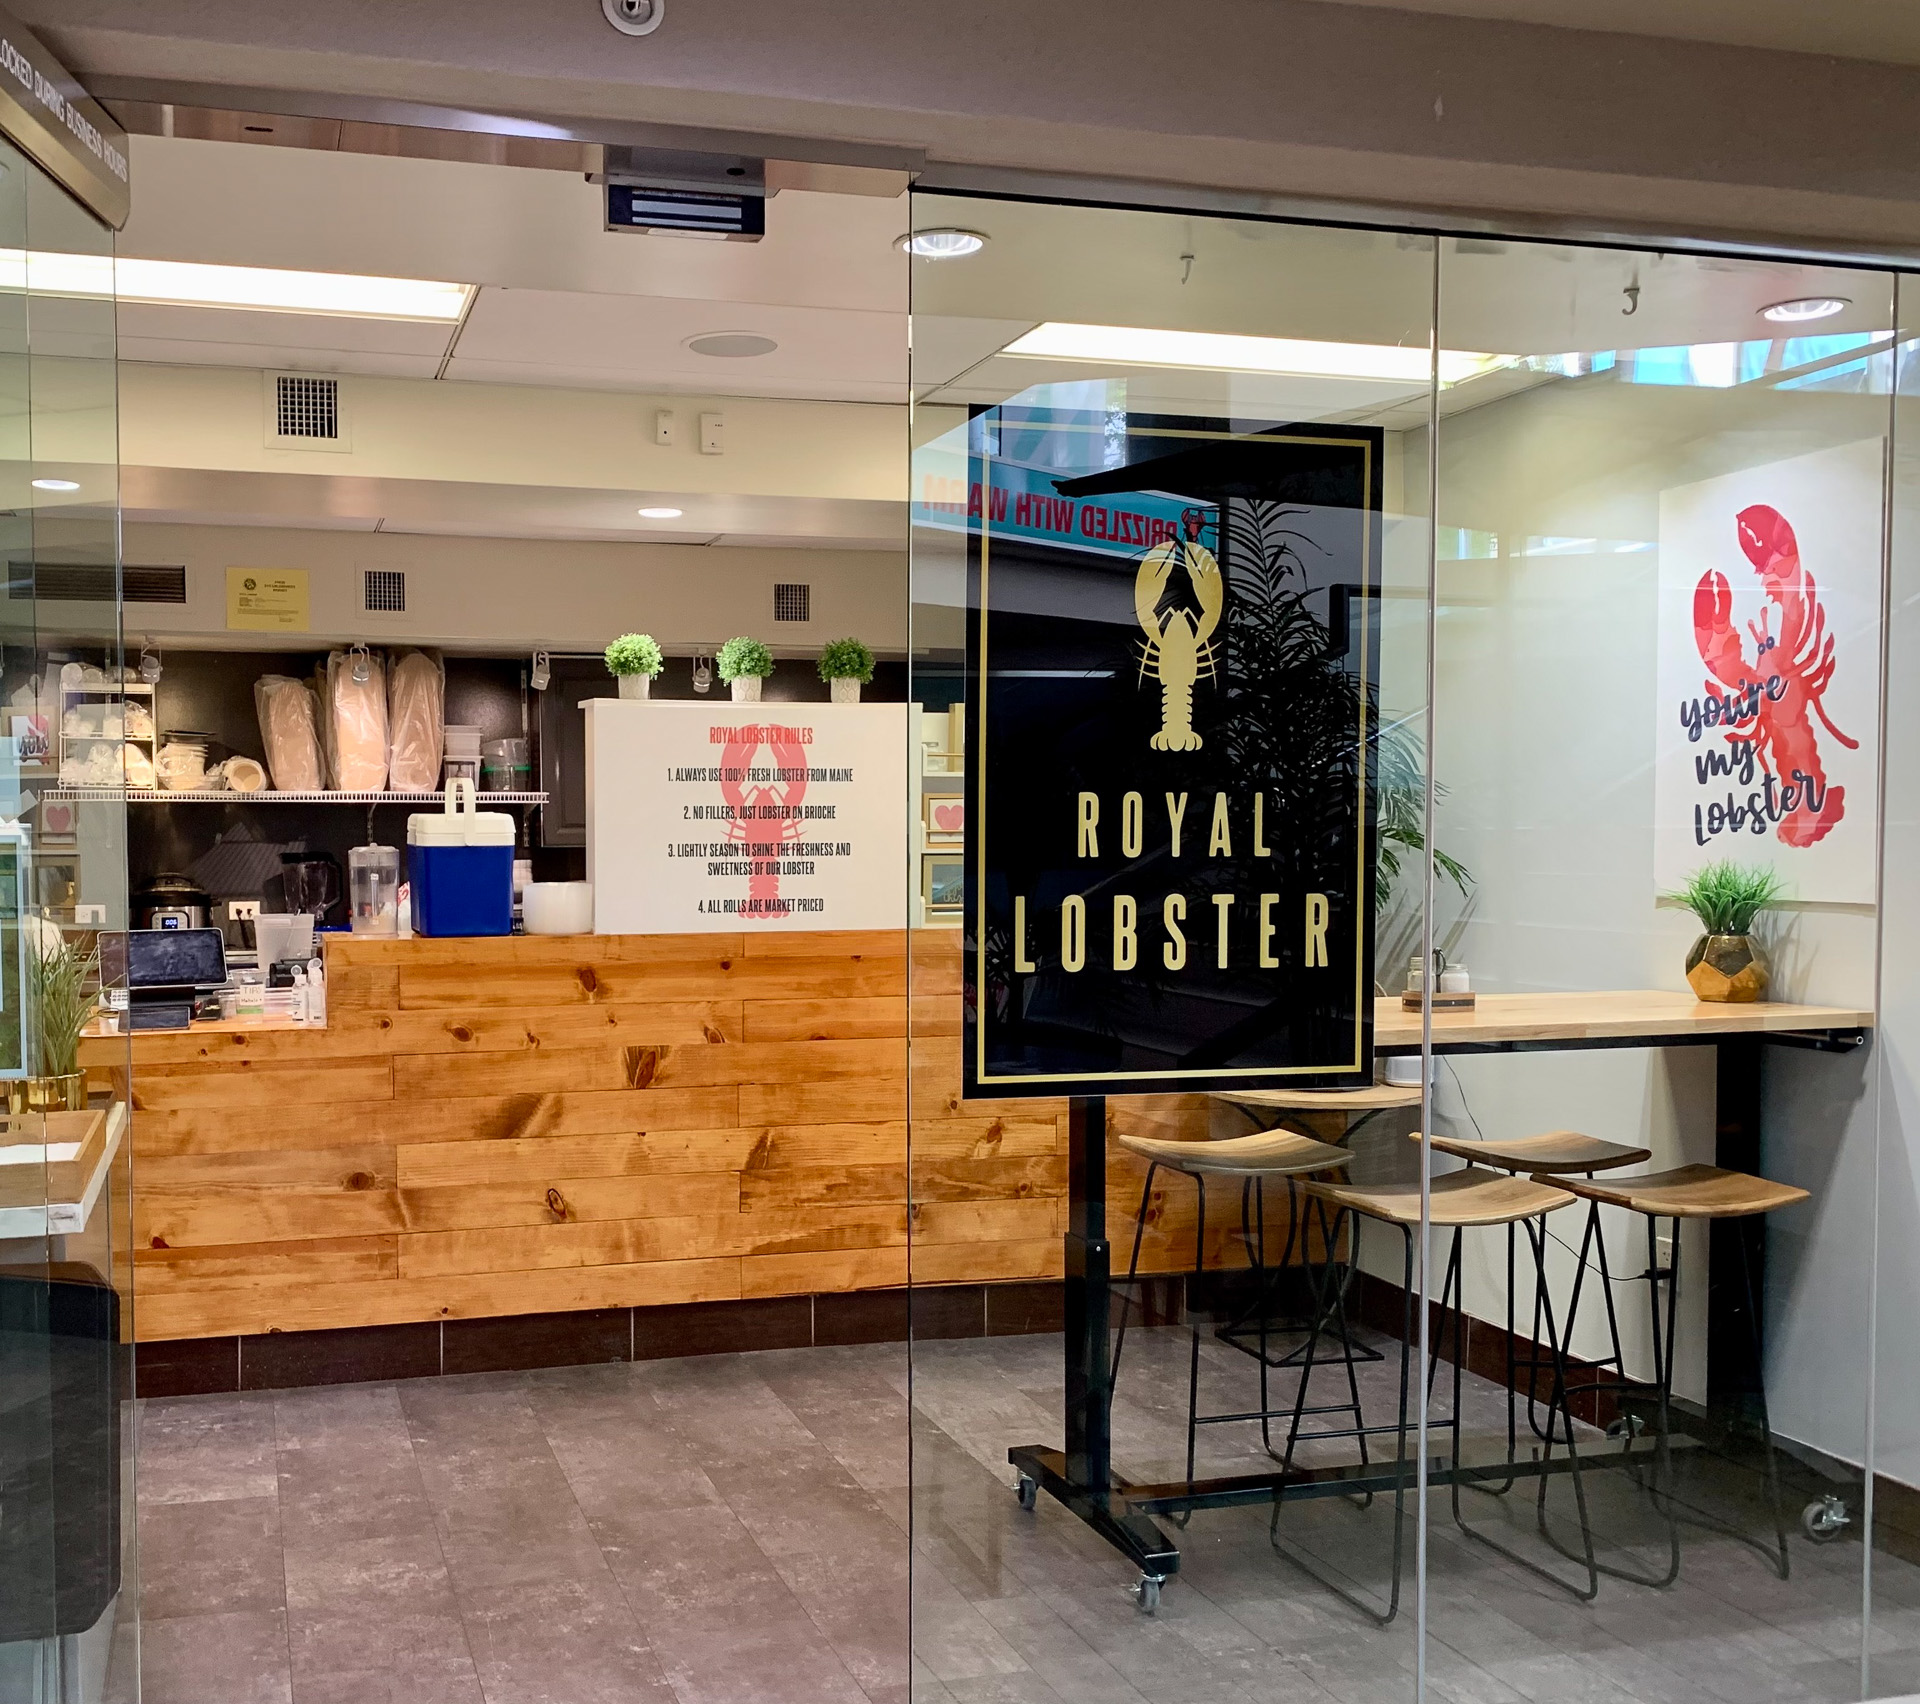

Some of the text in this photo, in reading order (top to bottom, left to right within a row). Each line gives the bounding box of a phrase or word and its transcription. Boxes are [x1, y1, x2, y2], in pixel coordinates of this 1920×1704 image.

[0, 38, 127, 183] OCKED DURING BUSINESS HOURS
[1680, 674, 1788, 742] you're
[709, 727, 813, 744] ROYAL LOBSTER RULES
[1695, 740, 1760, 785] my
[668, 767, 853, 782] 1. ALWAYS USE 100% FRESH LOBSTER FROM MAINE
[683, 805, 836, 819] 2. NO FILLERS, JUST LOBSTER ON BRIOCHE
[1078, 792, 1271, 858] ROYAL
[668, 843, 851, 857] 3. LIGHTLY SEASON TO SHINE THE FRESHNESS AND
[708, 862, 815, 875] SWEETNESS OF OUR LOBSTER
[698, 898, 824, 913] 4. ALL ROLLS ARE MARKET PRICED
[1015, 893, 1329, 973] LOBSTER
